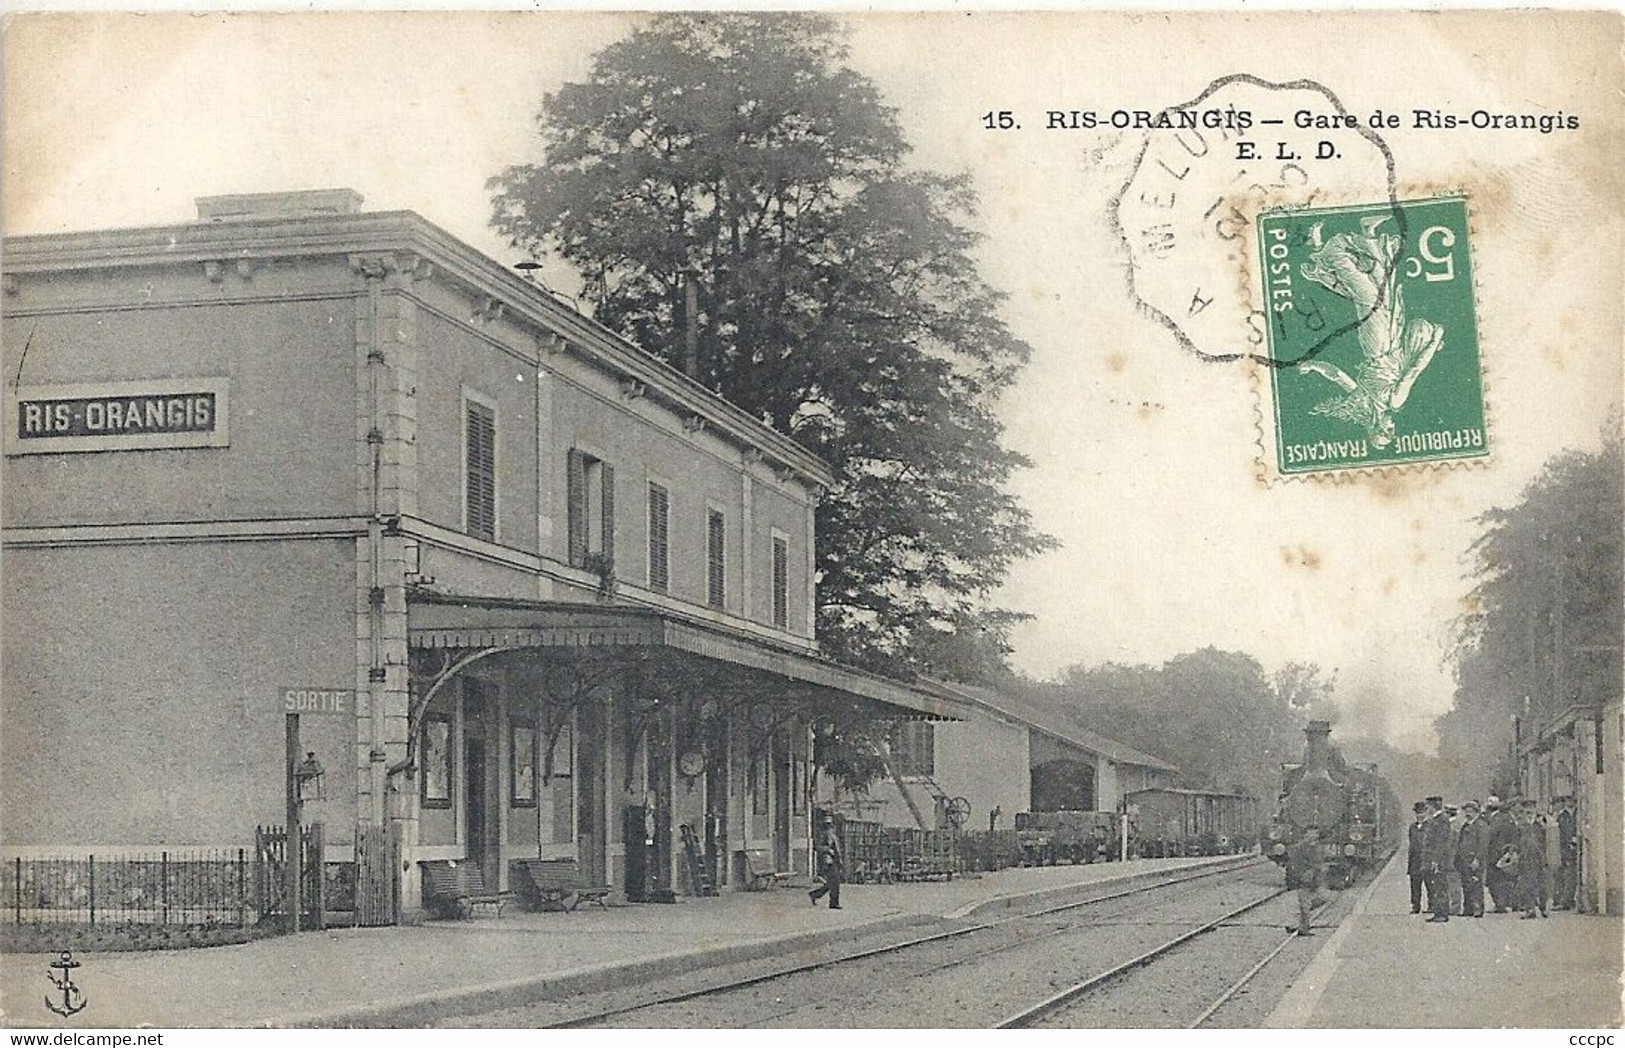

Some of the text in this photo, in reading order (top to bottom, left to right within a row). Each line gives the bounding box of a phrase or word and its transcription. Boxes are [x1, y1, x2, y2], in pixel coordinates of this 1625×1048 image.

[1267, 227, 1293, 313] POSTES
[24, 398, 212, 433] RIS-ORANGIS
[1286, 438, 1368, 464] FRANÇAISE
[284, 689, 348, 712] SORTIE
